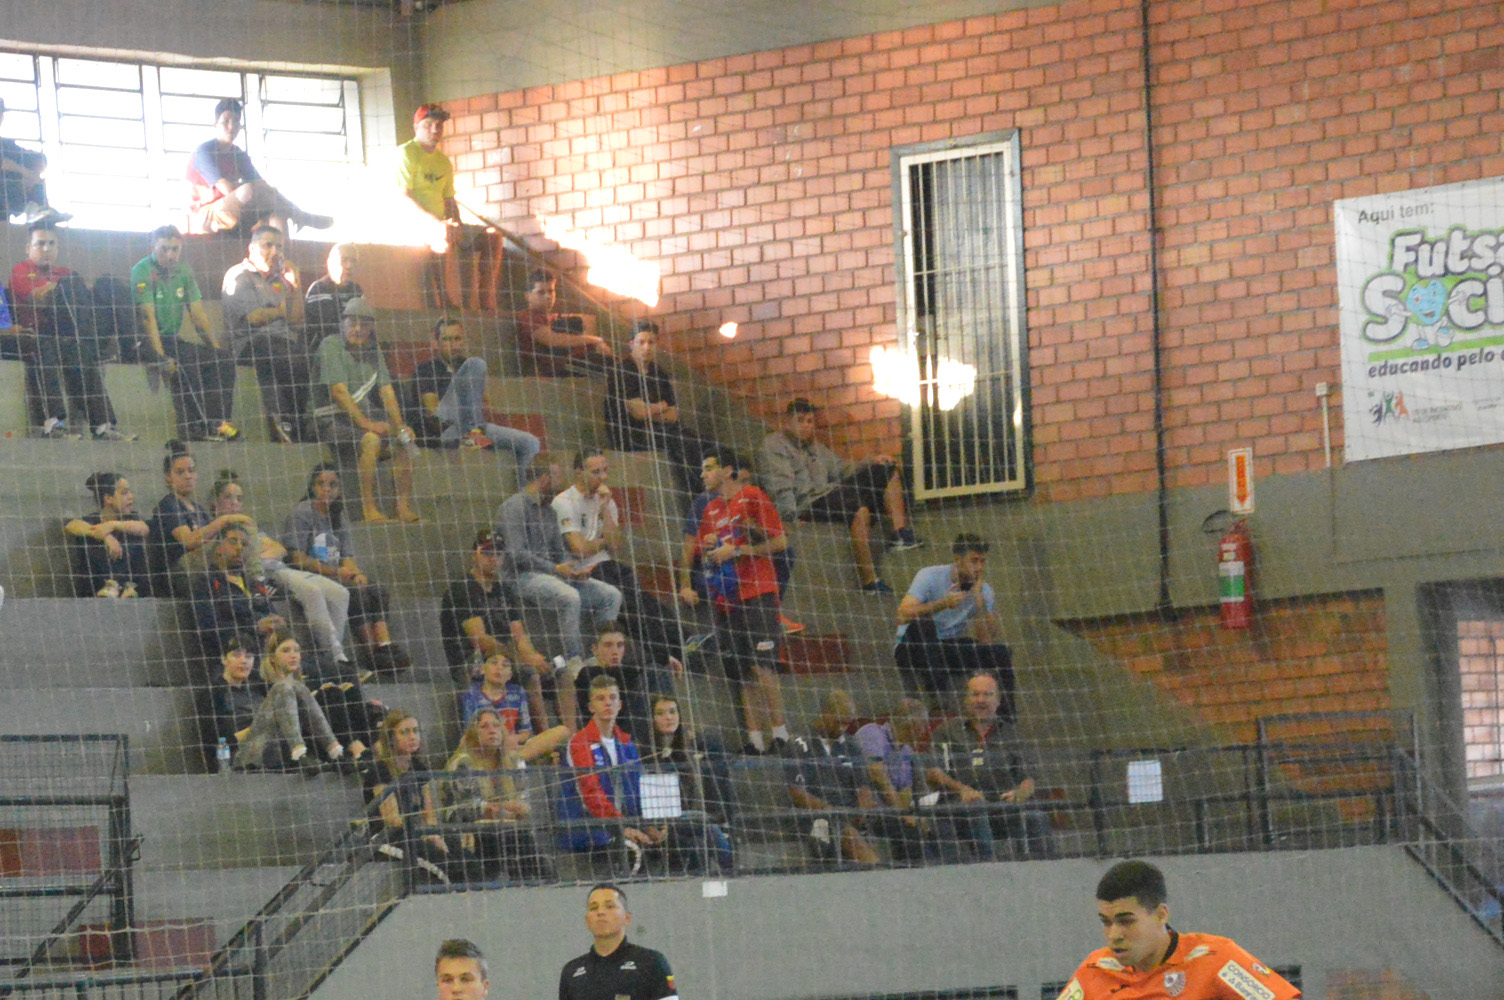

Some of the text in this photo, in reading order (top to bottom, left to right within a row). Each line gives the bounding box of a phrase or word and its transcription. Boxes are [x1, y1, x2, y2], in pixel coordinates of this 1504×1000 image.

[1357, 205, 1395, 225] Aqui
[1389, 225, 1504, 279] Futs
[1368, 353, 1453, 378] educando
[1456, 347, 1495, 371] pelo
